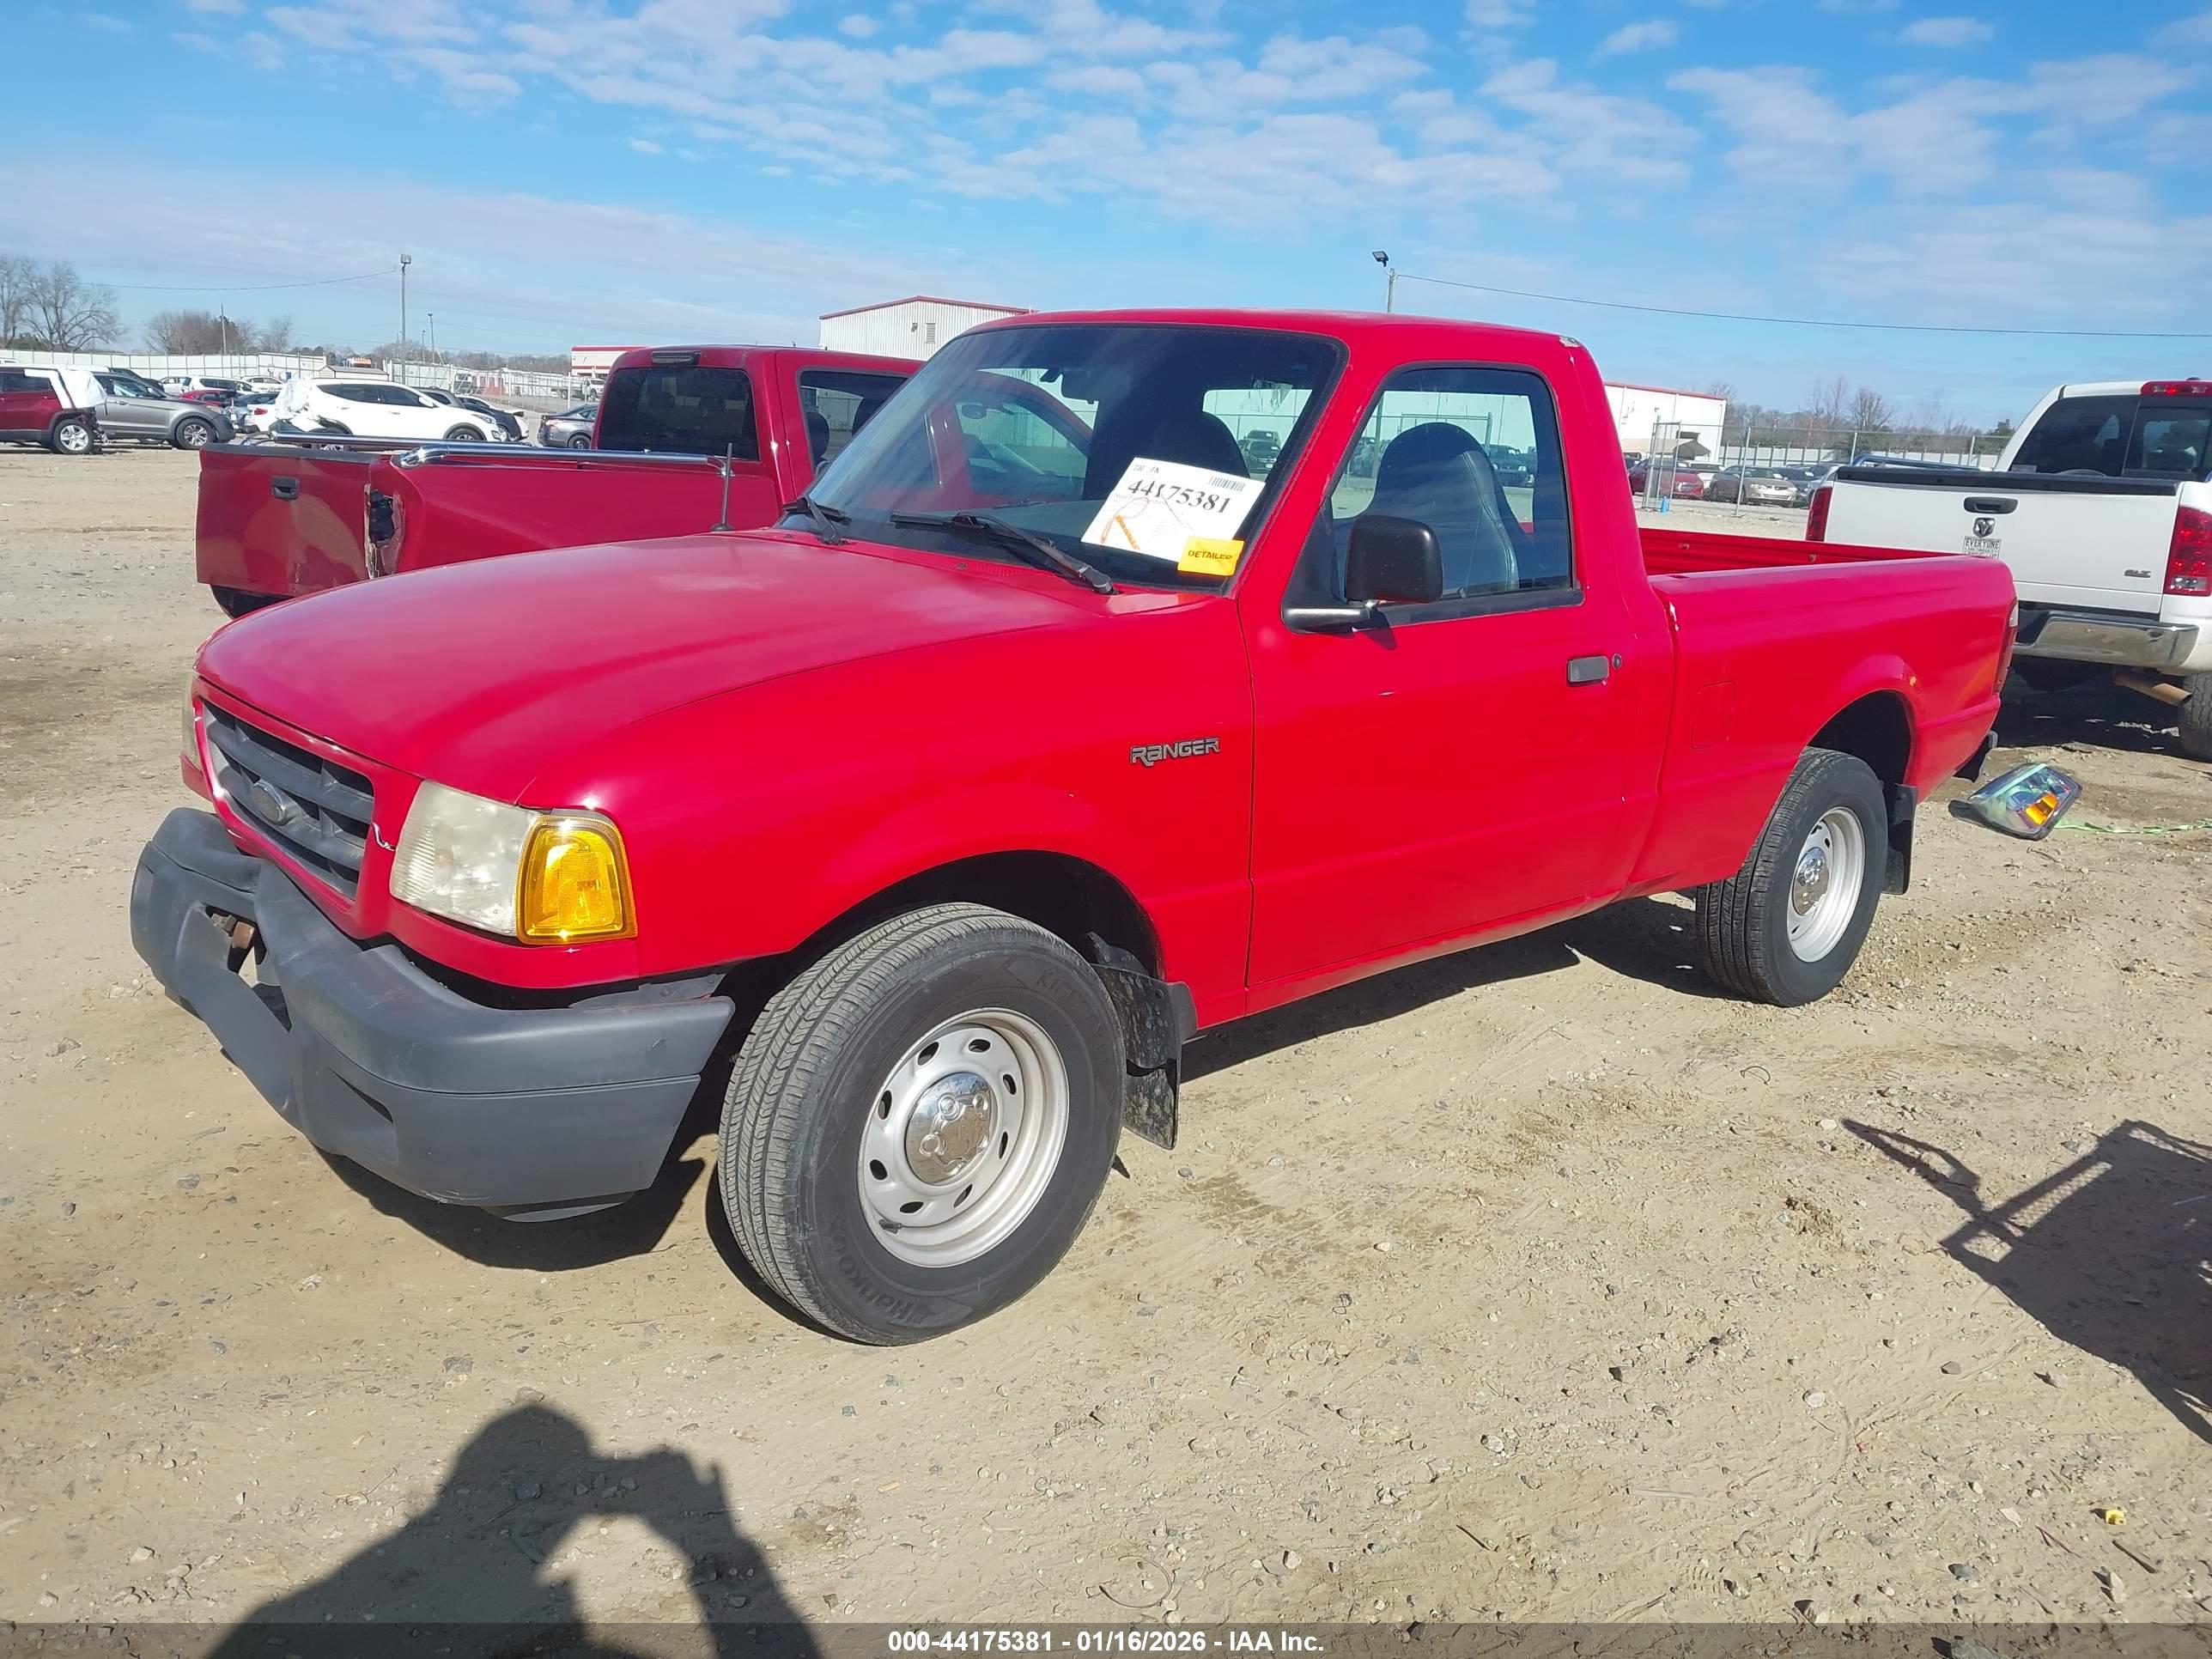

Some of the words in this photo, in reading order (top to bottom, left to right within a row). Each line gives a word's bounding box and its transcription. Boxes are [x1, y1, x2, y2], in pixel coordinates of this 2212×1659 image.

[1127, 478, 1231, 514] 44175381
[1966, 538, 2000, 549] EVERYONE
[1188, 550, 1233, 560] DETAILED
[1131, 738, 1220, 767] RANGER
